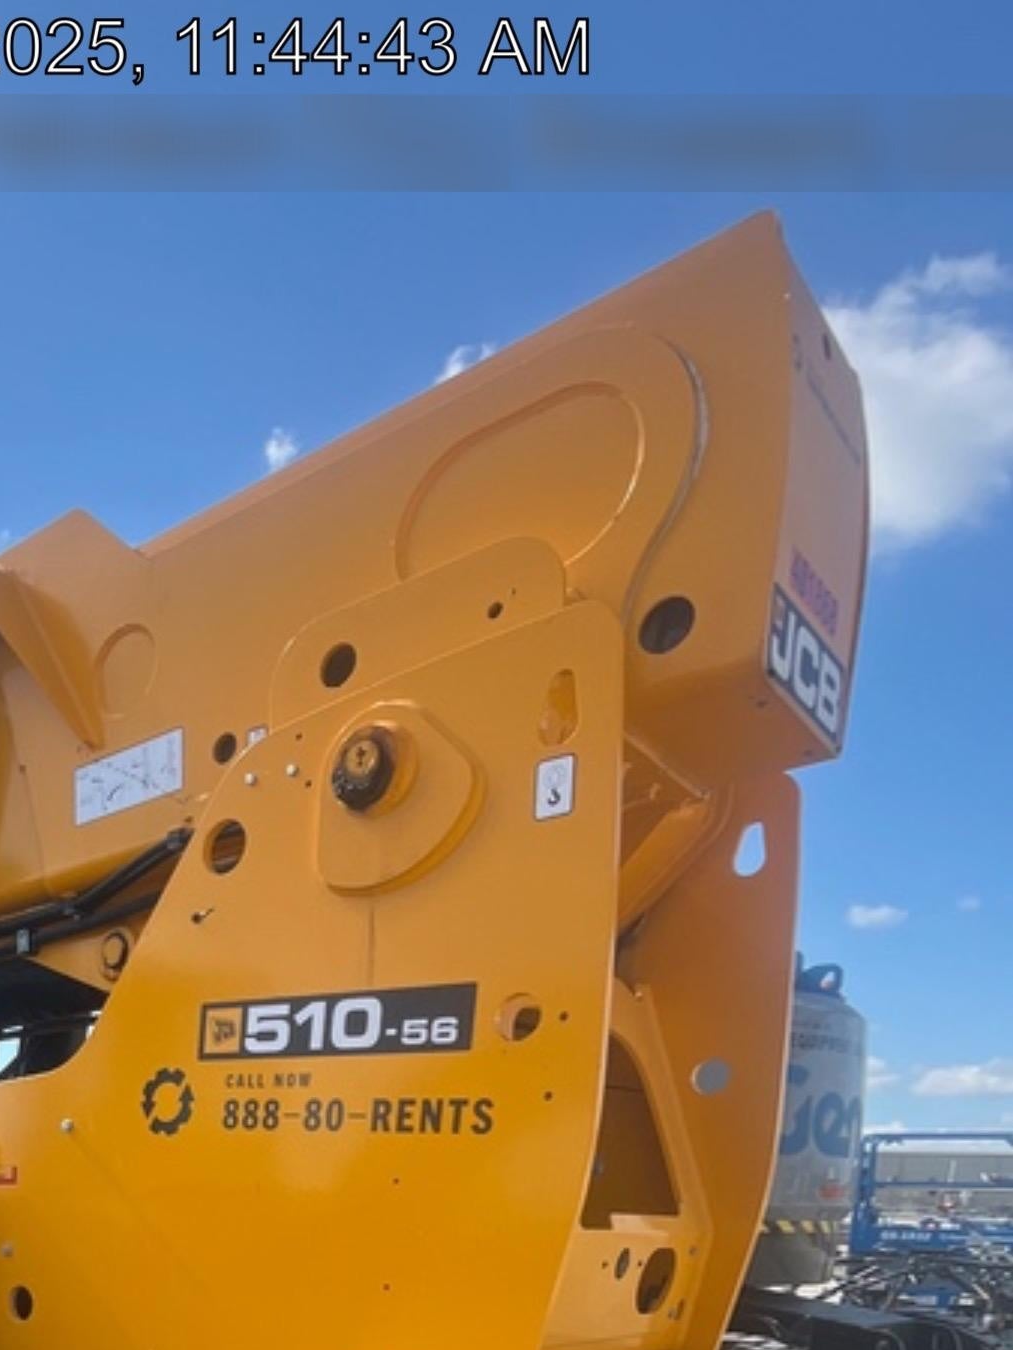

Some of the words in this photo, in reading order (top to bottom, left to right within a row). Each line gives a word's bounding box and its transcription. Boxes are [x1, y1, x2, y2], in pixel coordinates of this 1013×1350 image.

[771, 606, 841, 734] JCB
[225, 1073, 265, 1090] CALL
[273, 1072, 312, 1088] NOW
[222, 1097, 495, 1135] 888-80-RENTS
